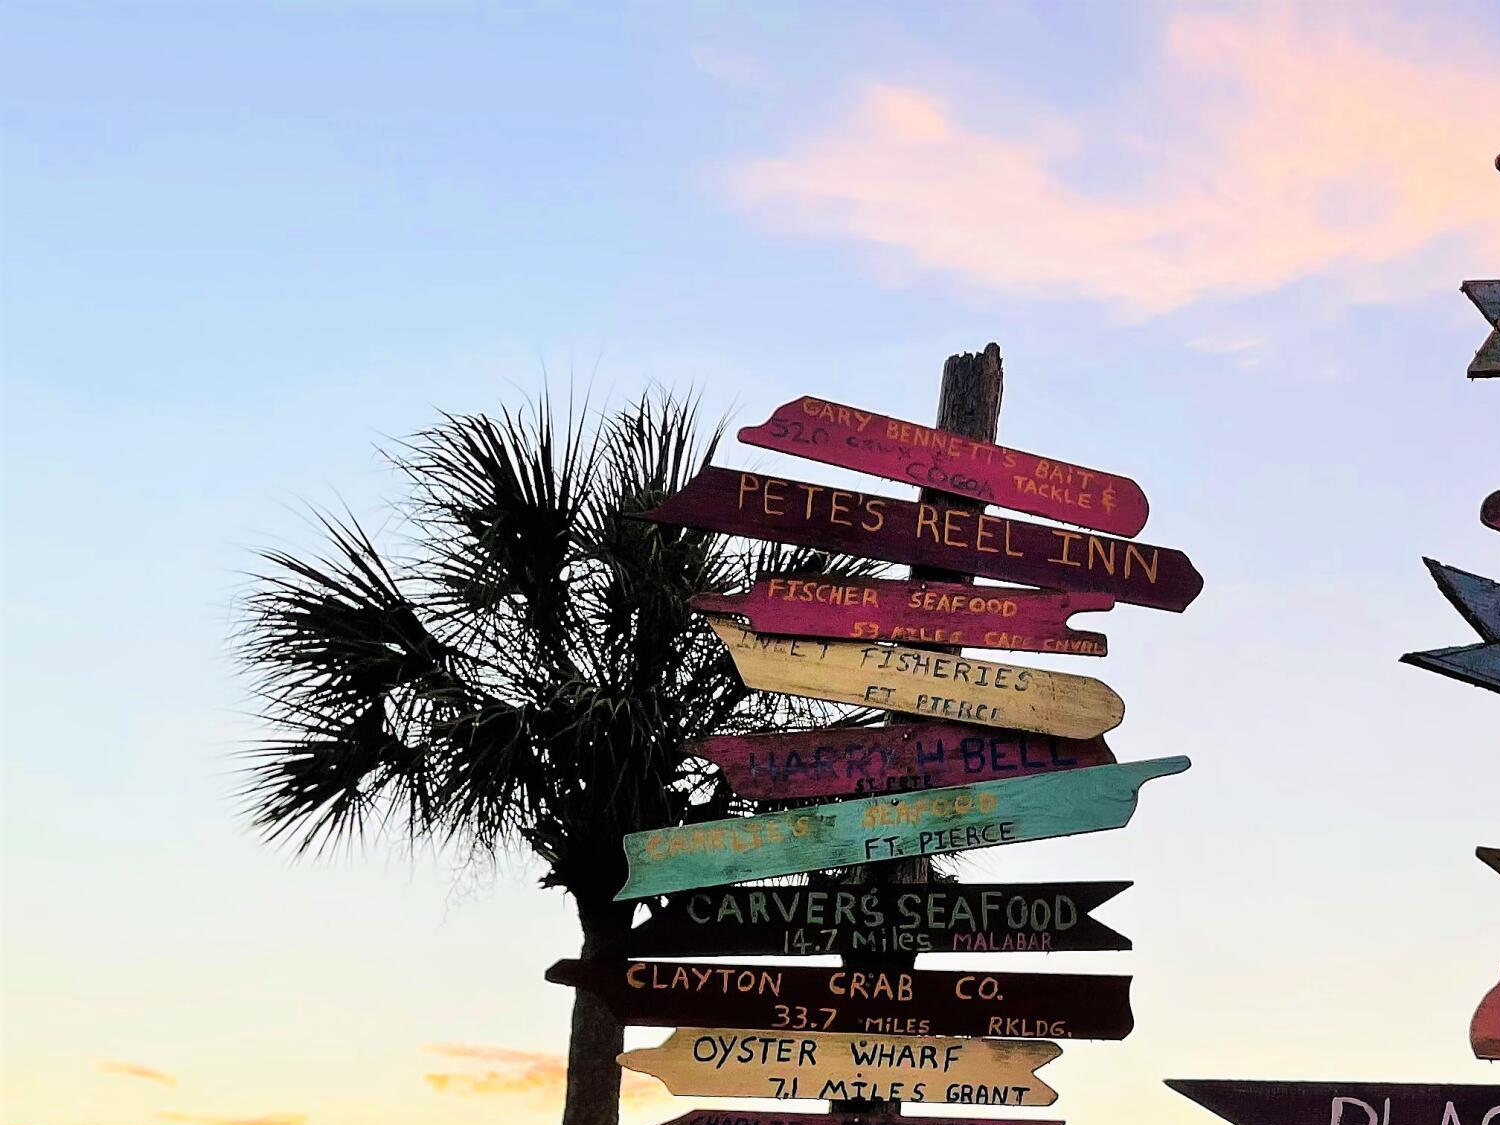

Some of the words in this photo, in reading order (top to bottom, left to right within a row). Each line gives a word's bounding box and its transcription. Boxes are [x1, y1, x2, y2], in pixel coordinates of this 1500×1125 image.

[803, 400, 872, 433] GARY
[1014, 475, 1094, 508] TACKLE
[738, 474, 888, 532] PETE'S
[917, 504, 1026, 559] REEL
[1048, 530, 1161, 585] INN
[768, 578, 881, 609] FISCHER
[907, 592, 1020, 619] SEAFOOD
[860, 648, 1034, 694] FISHERIES
[959, 737, 1076, 775] BELL
[918, 822, 1014, 850] PIERCE
[897, 889, 1080, 931] SEAFOOD
[784, 928, 839, 954] 14.7
[952, 932, 1054, 951] MALABAR
[626, 963, 783, 998] CLAYTON
[828, 970, 914, 1002] CRAB
[774, 1003, 838, 1030] 33.7
[693, 1036, 818, 1070] OYSTER
[851, 1043, 963, 1074] WHARF
[819, 1079, 926, 1103] MILES
[945, 1084, 1030, 1105] GRANT
